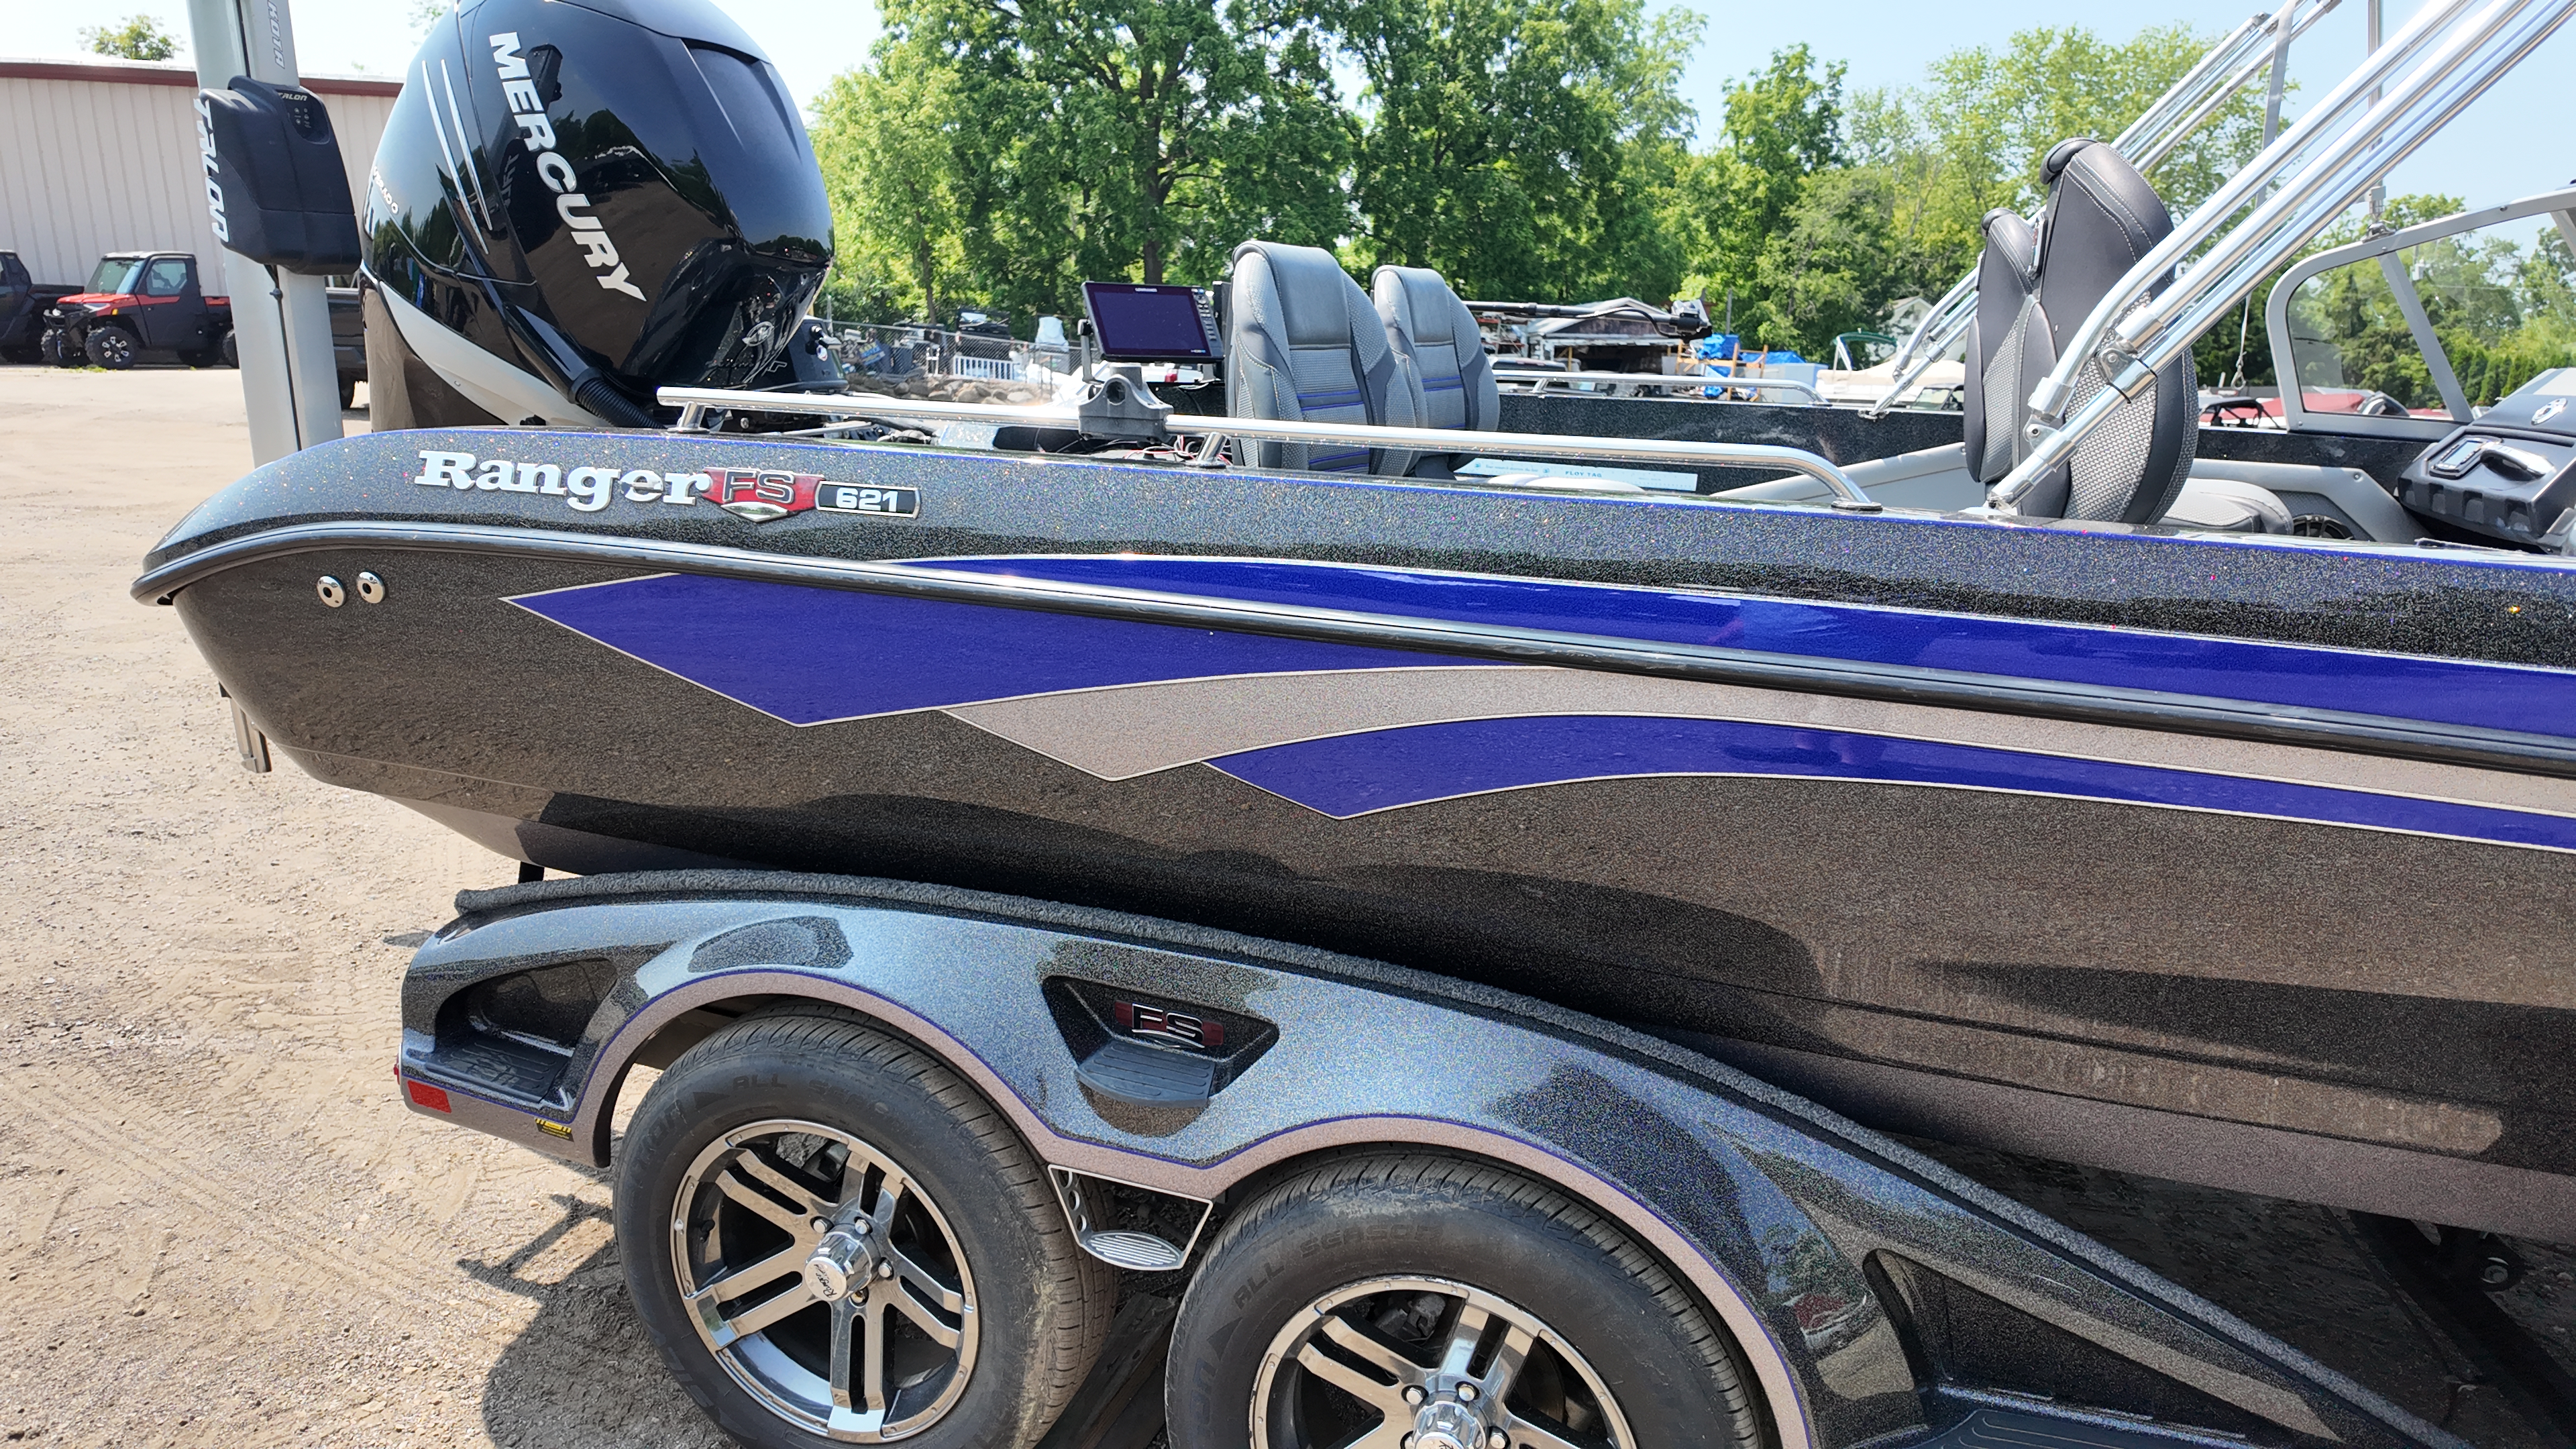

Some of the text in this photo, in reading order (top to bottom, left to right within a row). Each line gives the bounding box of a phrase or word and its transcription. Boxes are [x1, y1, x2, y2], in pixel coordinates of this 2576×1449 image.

[193, 99, 229, 242] TALON
[489, 32, 647, 302] MERCURY
[415, 449, 898, 513] Ranger FS 621
[1132, 1003, 1205, 1043] FS
[1233, 1262, 1285, 1310] ALL
